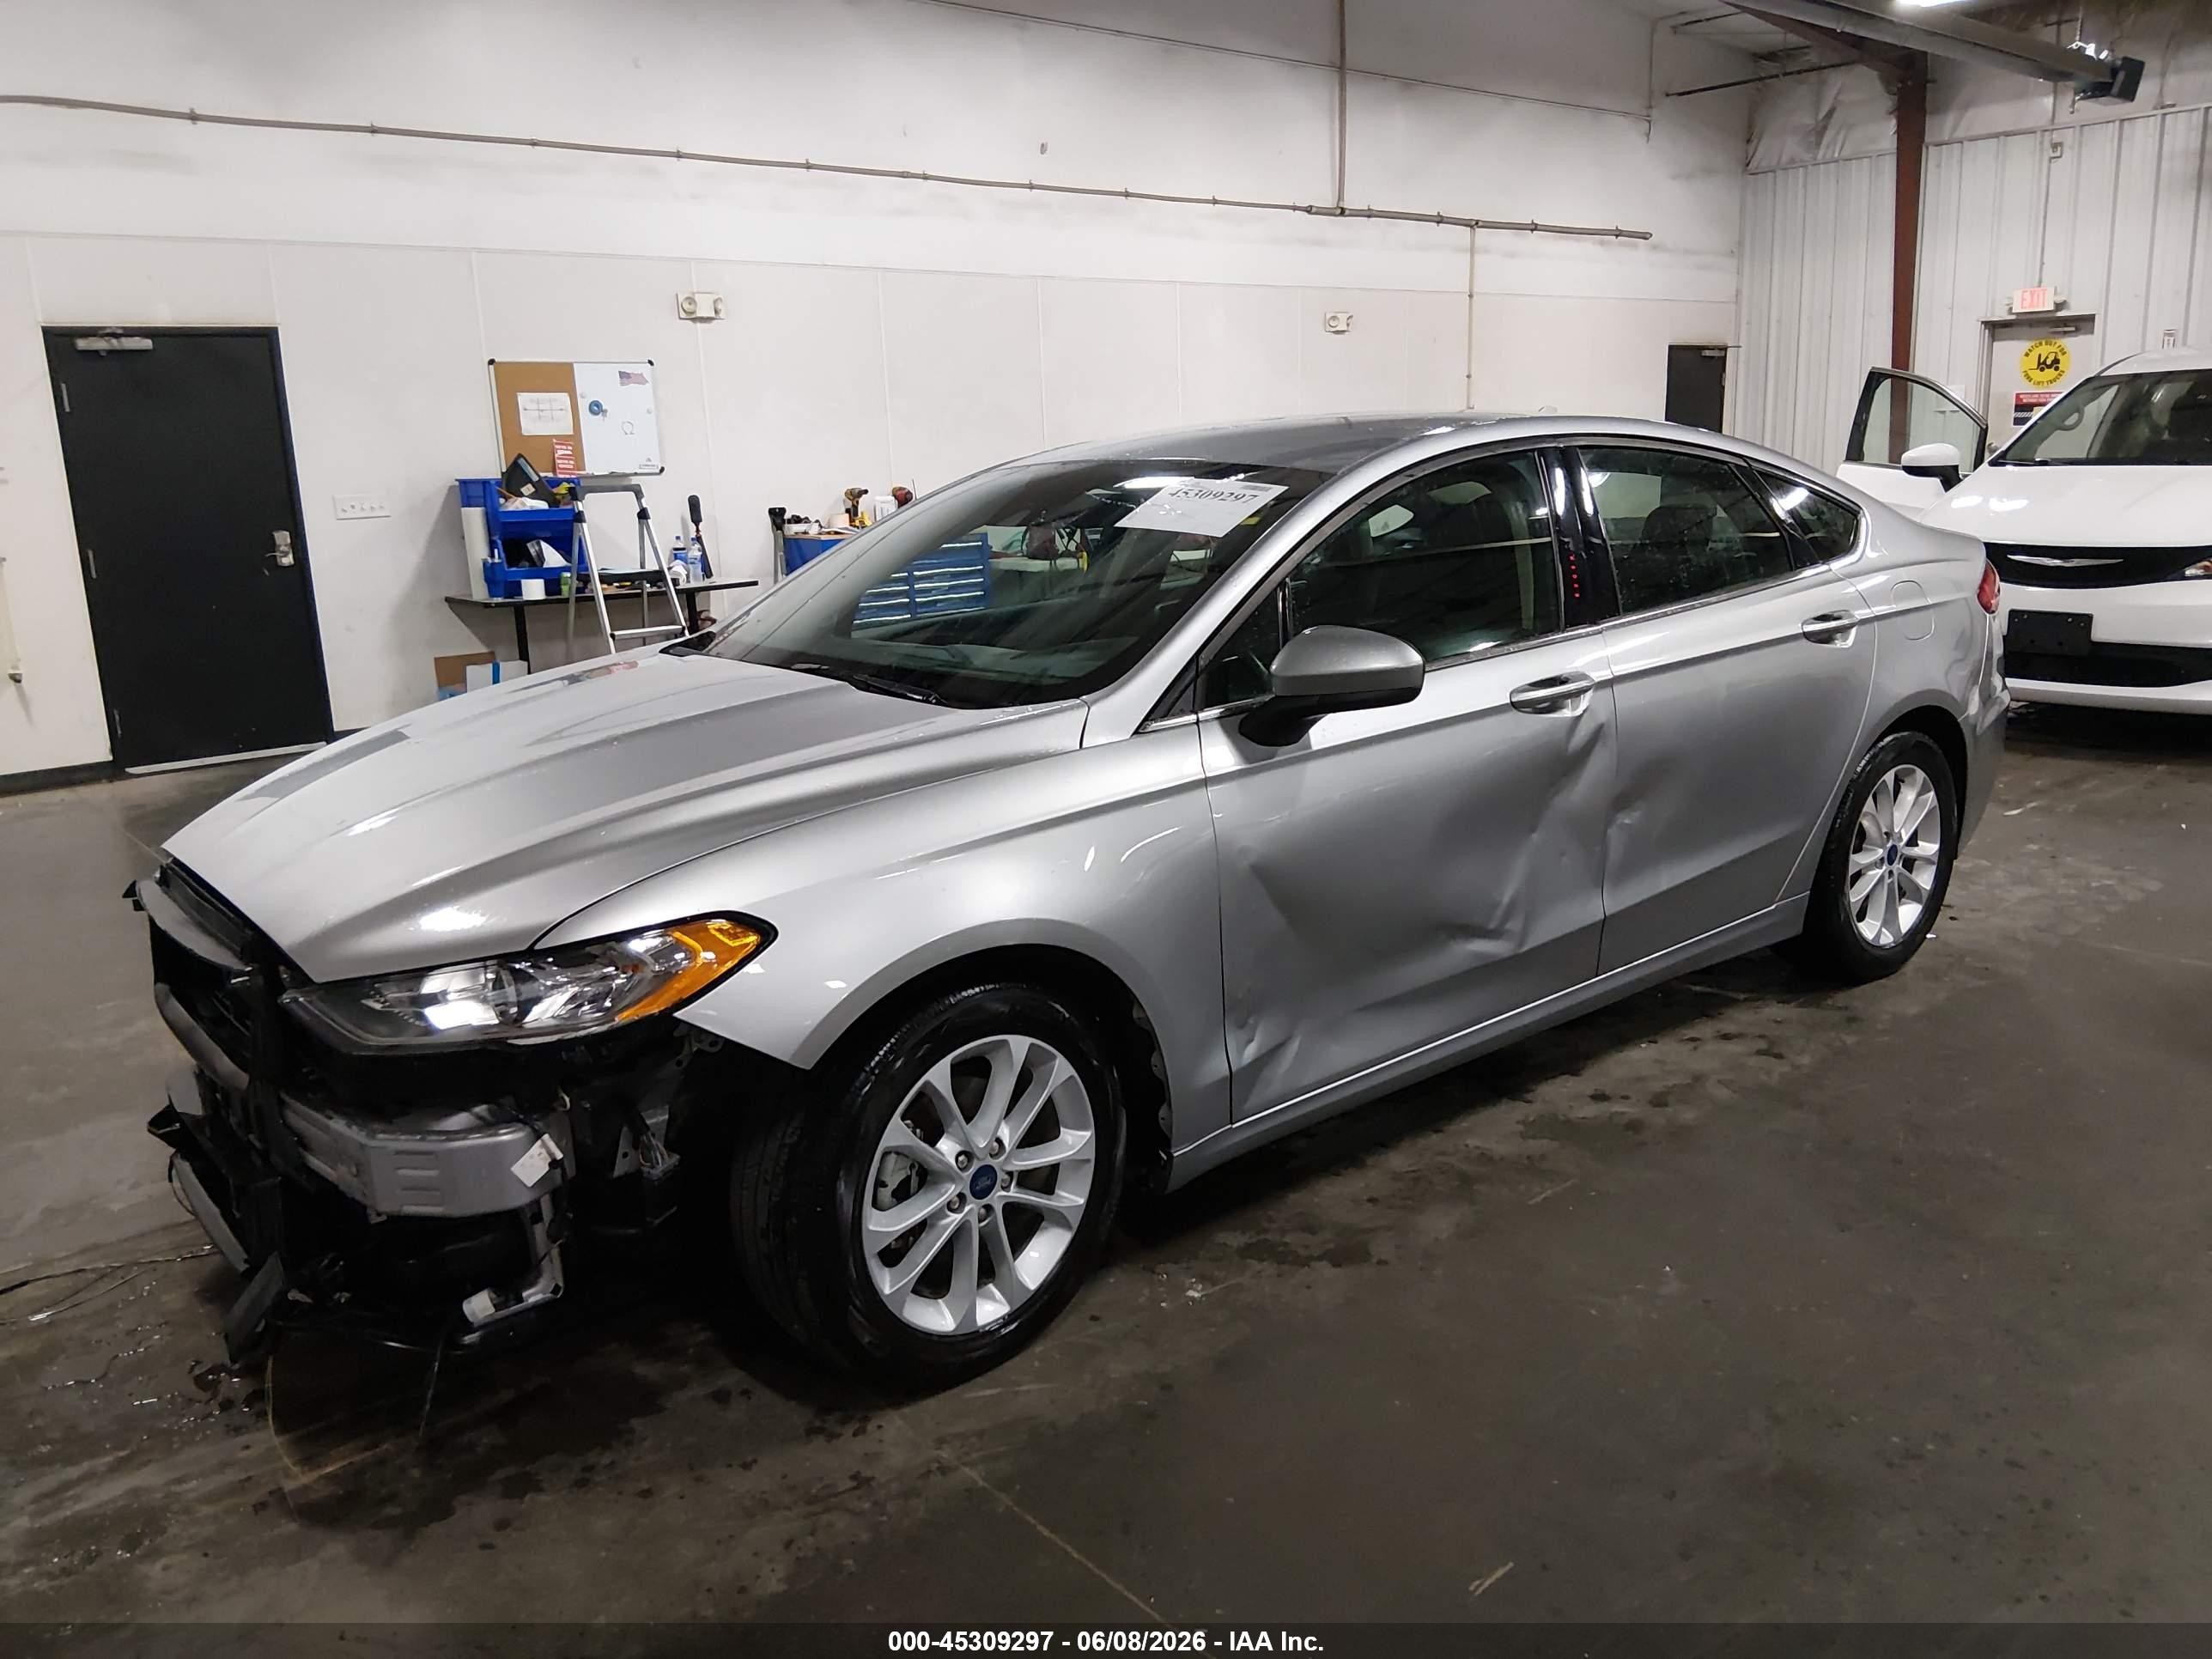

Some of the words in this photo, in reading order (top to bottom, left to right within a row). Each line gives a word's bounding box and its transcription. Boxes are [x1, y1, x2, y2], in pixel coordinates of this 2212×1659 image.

[2021, 289, 2048, 309] EXIT
[2024, 341, 2043, 357] WATCH
[2057, 344, 2068, 356] FOR
[2022, 370, 2033, 383] FORK
[1169, 488, 1260, 503] 45309297
